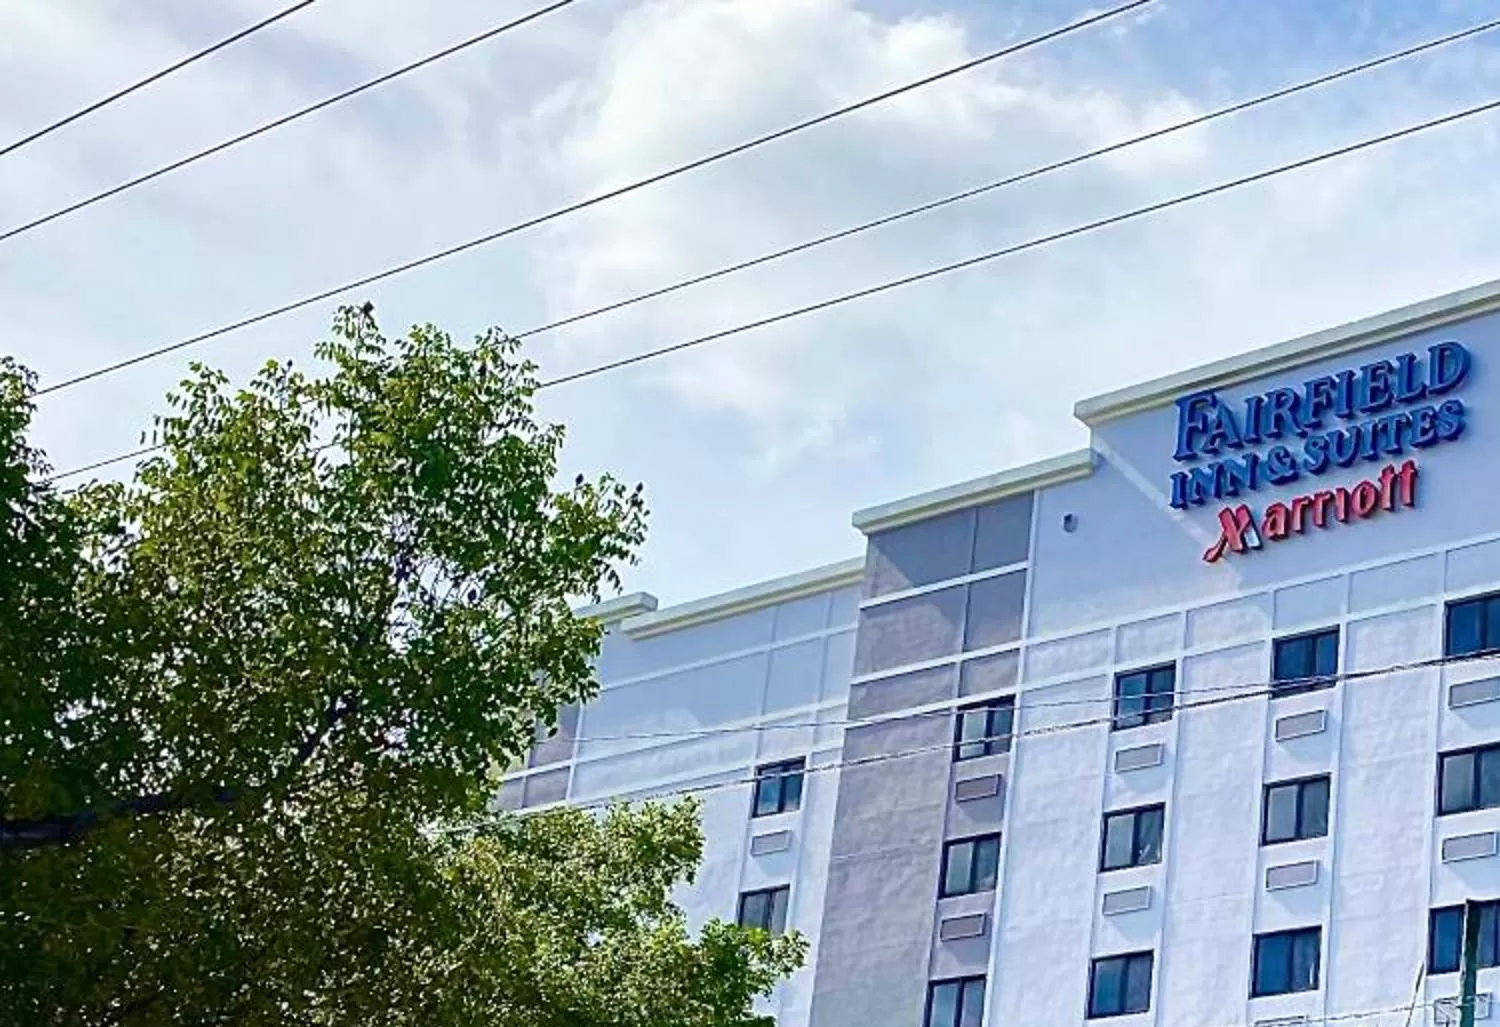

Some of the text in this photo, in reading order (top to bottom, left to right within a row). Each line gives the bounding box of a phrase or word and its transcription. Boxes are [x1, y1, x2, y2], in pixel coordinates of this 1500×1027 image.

[1169, 399, 1467, 509] INN & SUITES
[1173, 341, 1471, 461] FAIRFIELD
[1203, 459, 1418, 562] Marriott
